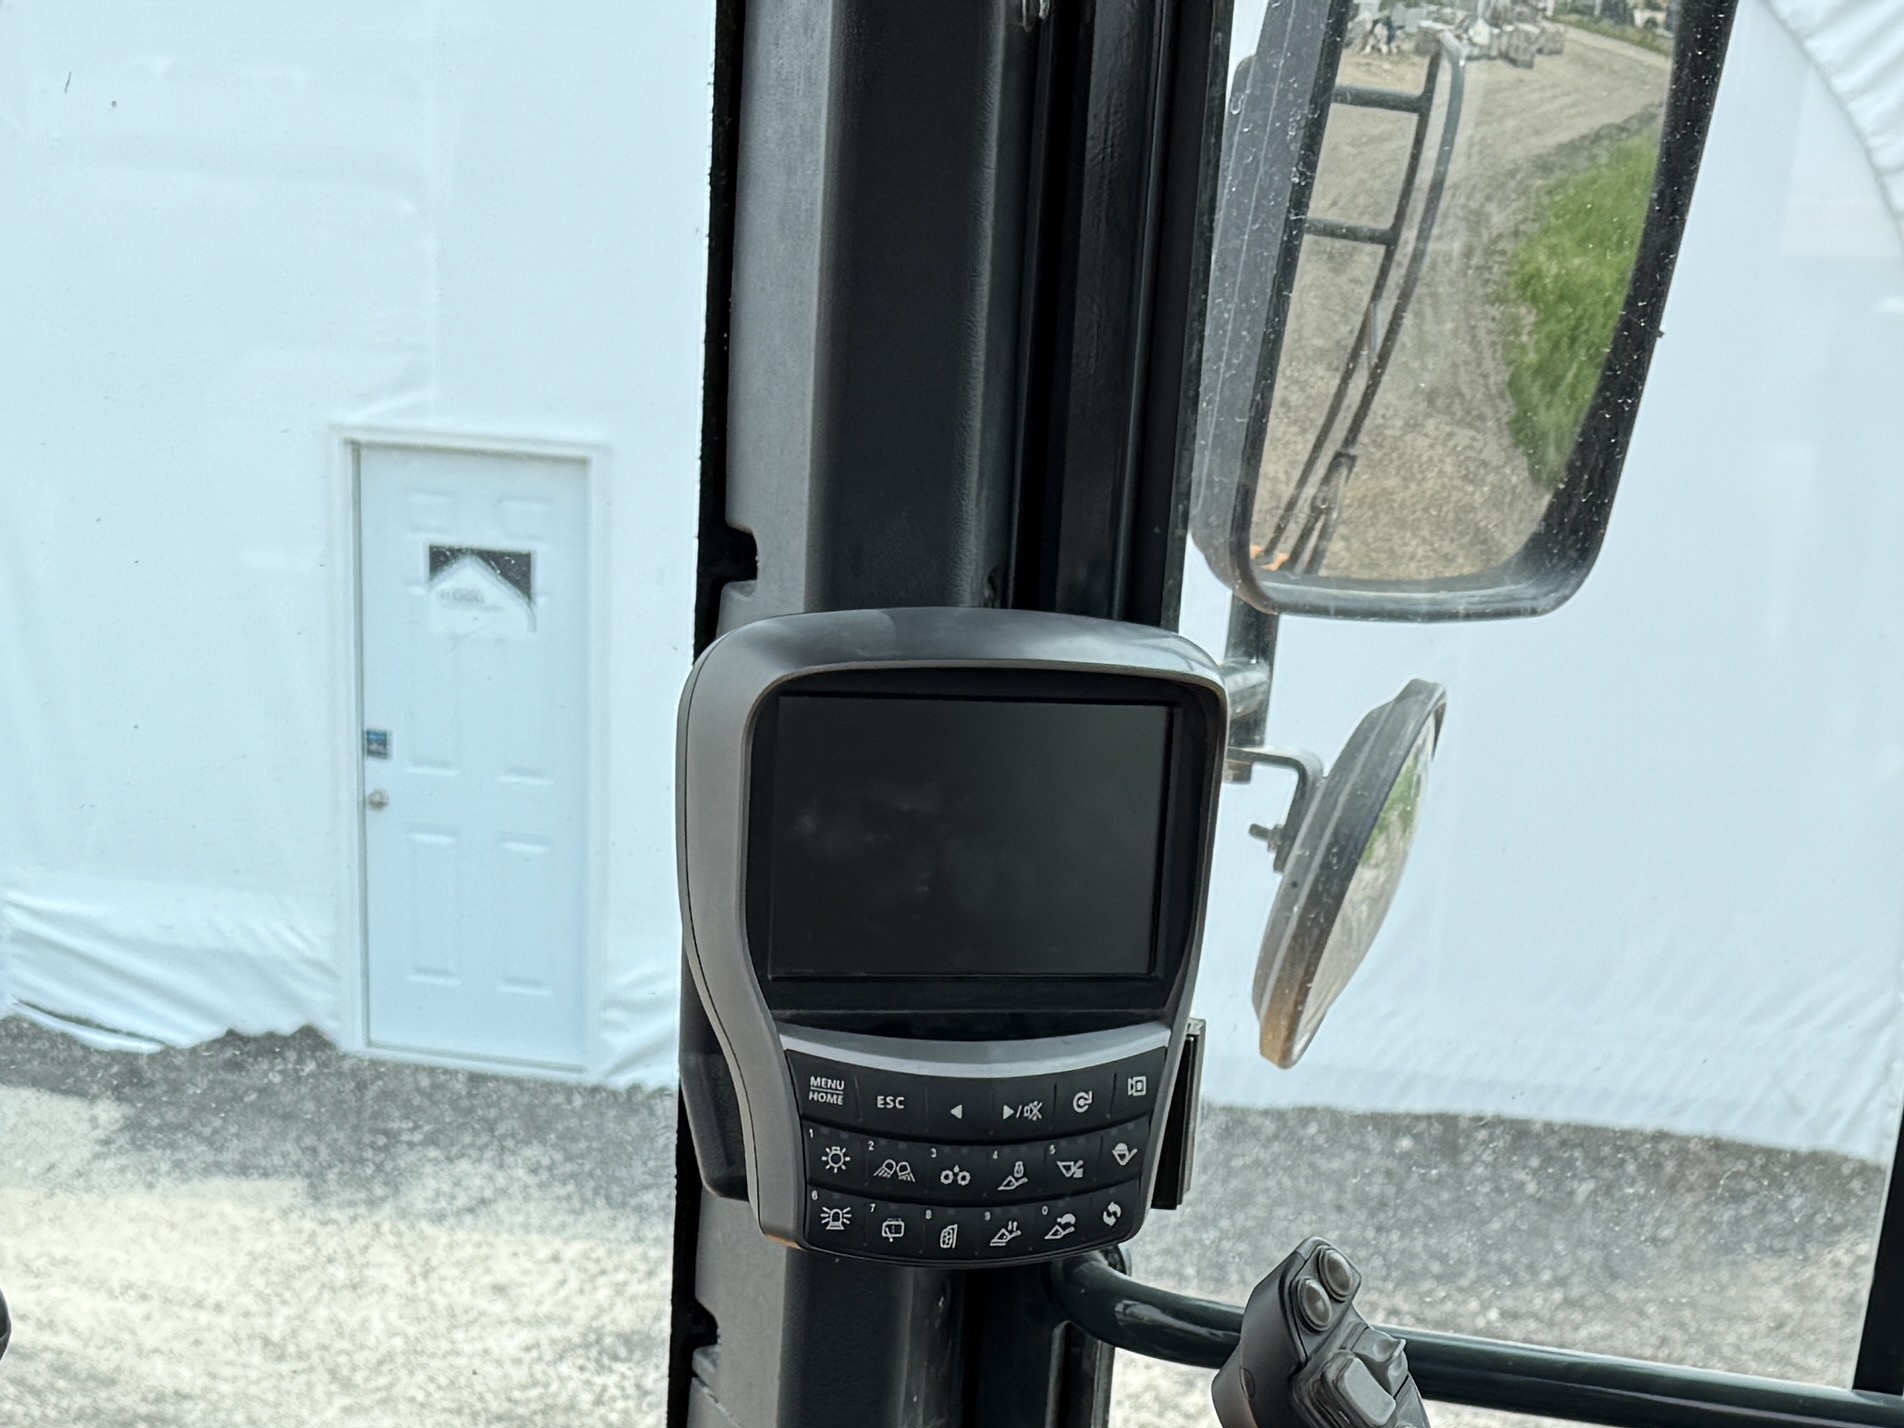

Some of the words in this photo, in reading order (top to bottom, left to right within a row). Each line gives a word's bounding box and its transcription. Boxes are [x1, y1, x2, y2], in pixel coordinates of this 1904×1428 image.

[810, 1076, 845, 1091] MENU
[809, 1092, 844, 1106] HOME
[877, 1095, 905, 1109] ESC
